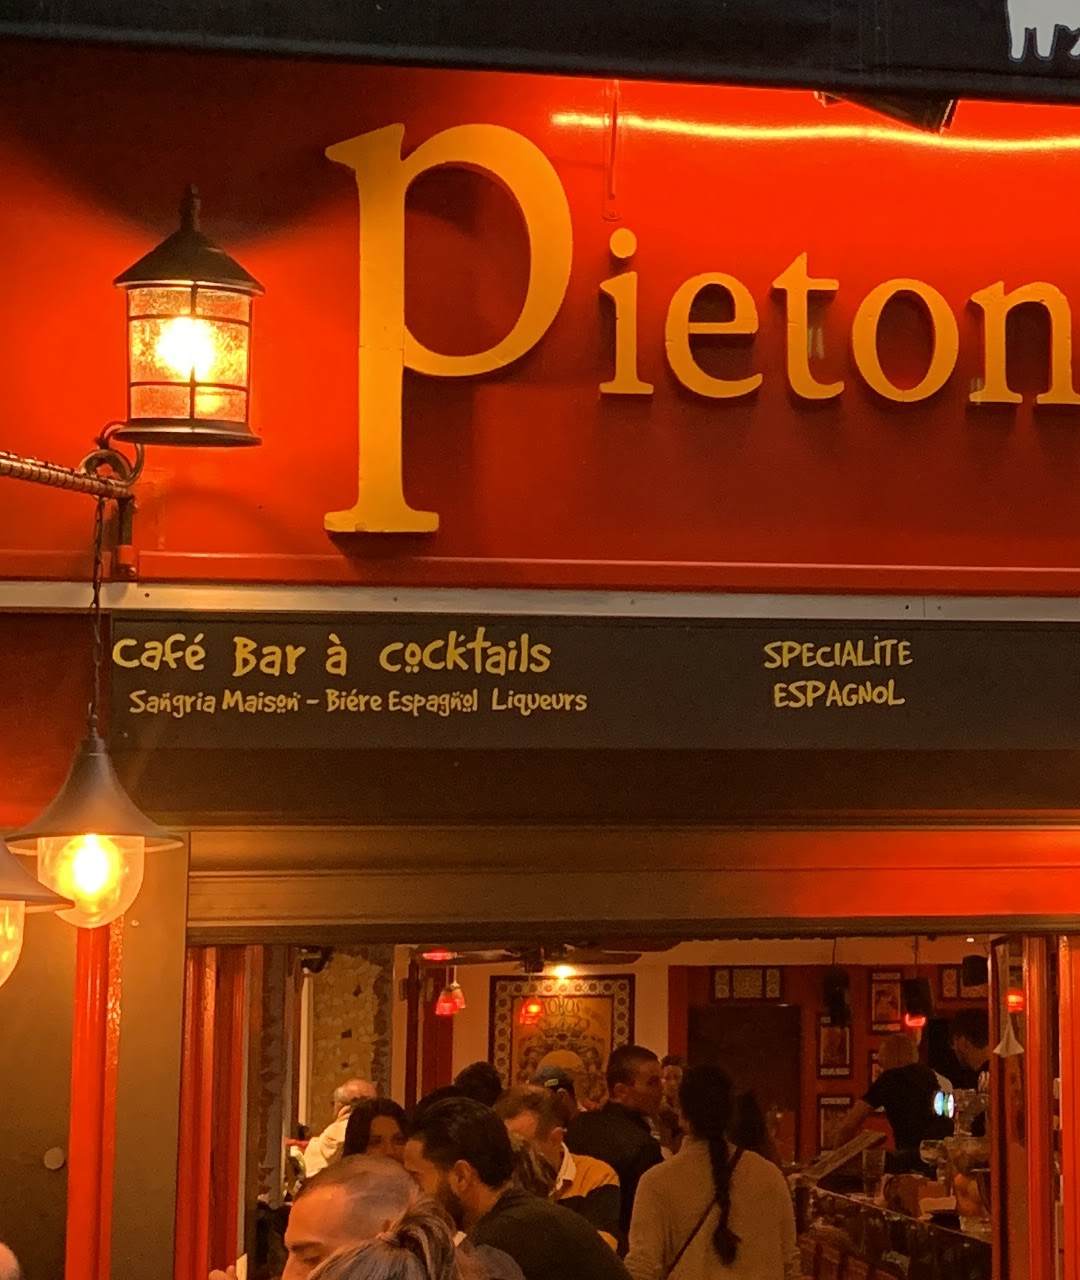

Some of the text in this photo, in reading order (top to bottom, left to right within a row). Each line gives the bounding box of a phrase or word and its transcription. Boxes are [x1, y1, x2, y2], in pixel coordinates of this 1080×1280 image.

[232, 636, 306, 677] Bar
[325, 633, 348, 677] à
[129, 689, 216, 719] Sangria
[221, 689, 301, 714] Maison
[388, 688, 479, 718] Espagnol
[491, 687, 588, 716] Liqueurs
